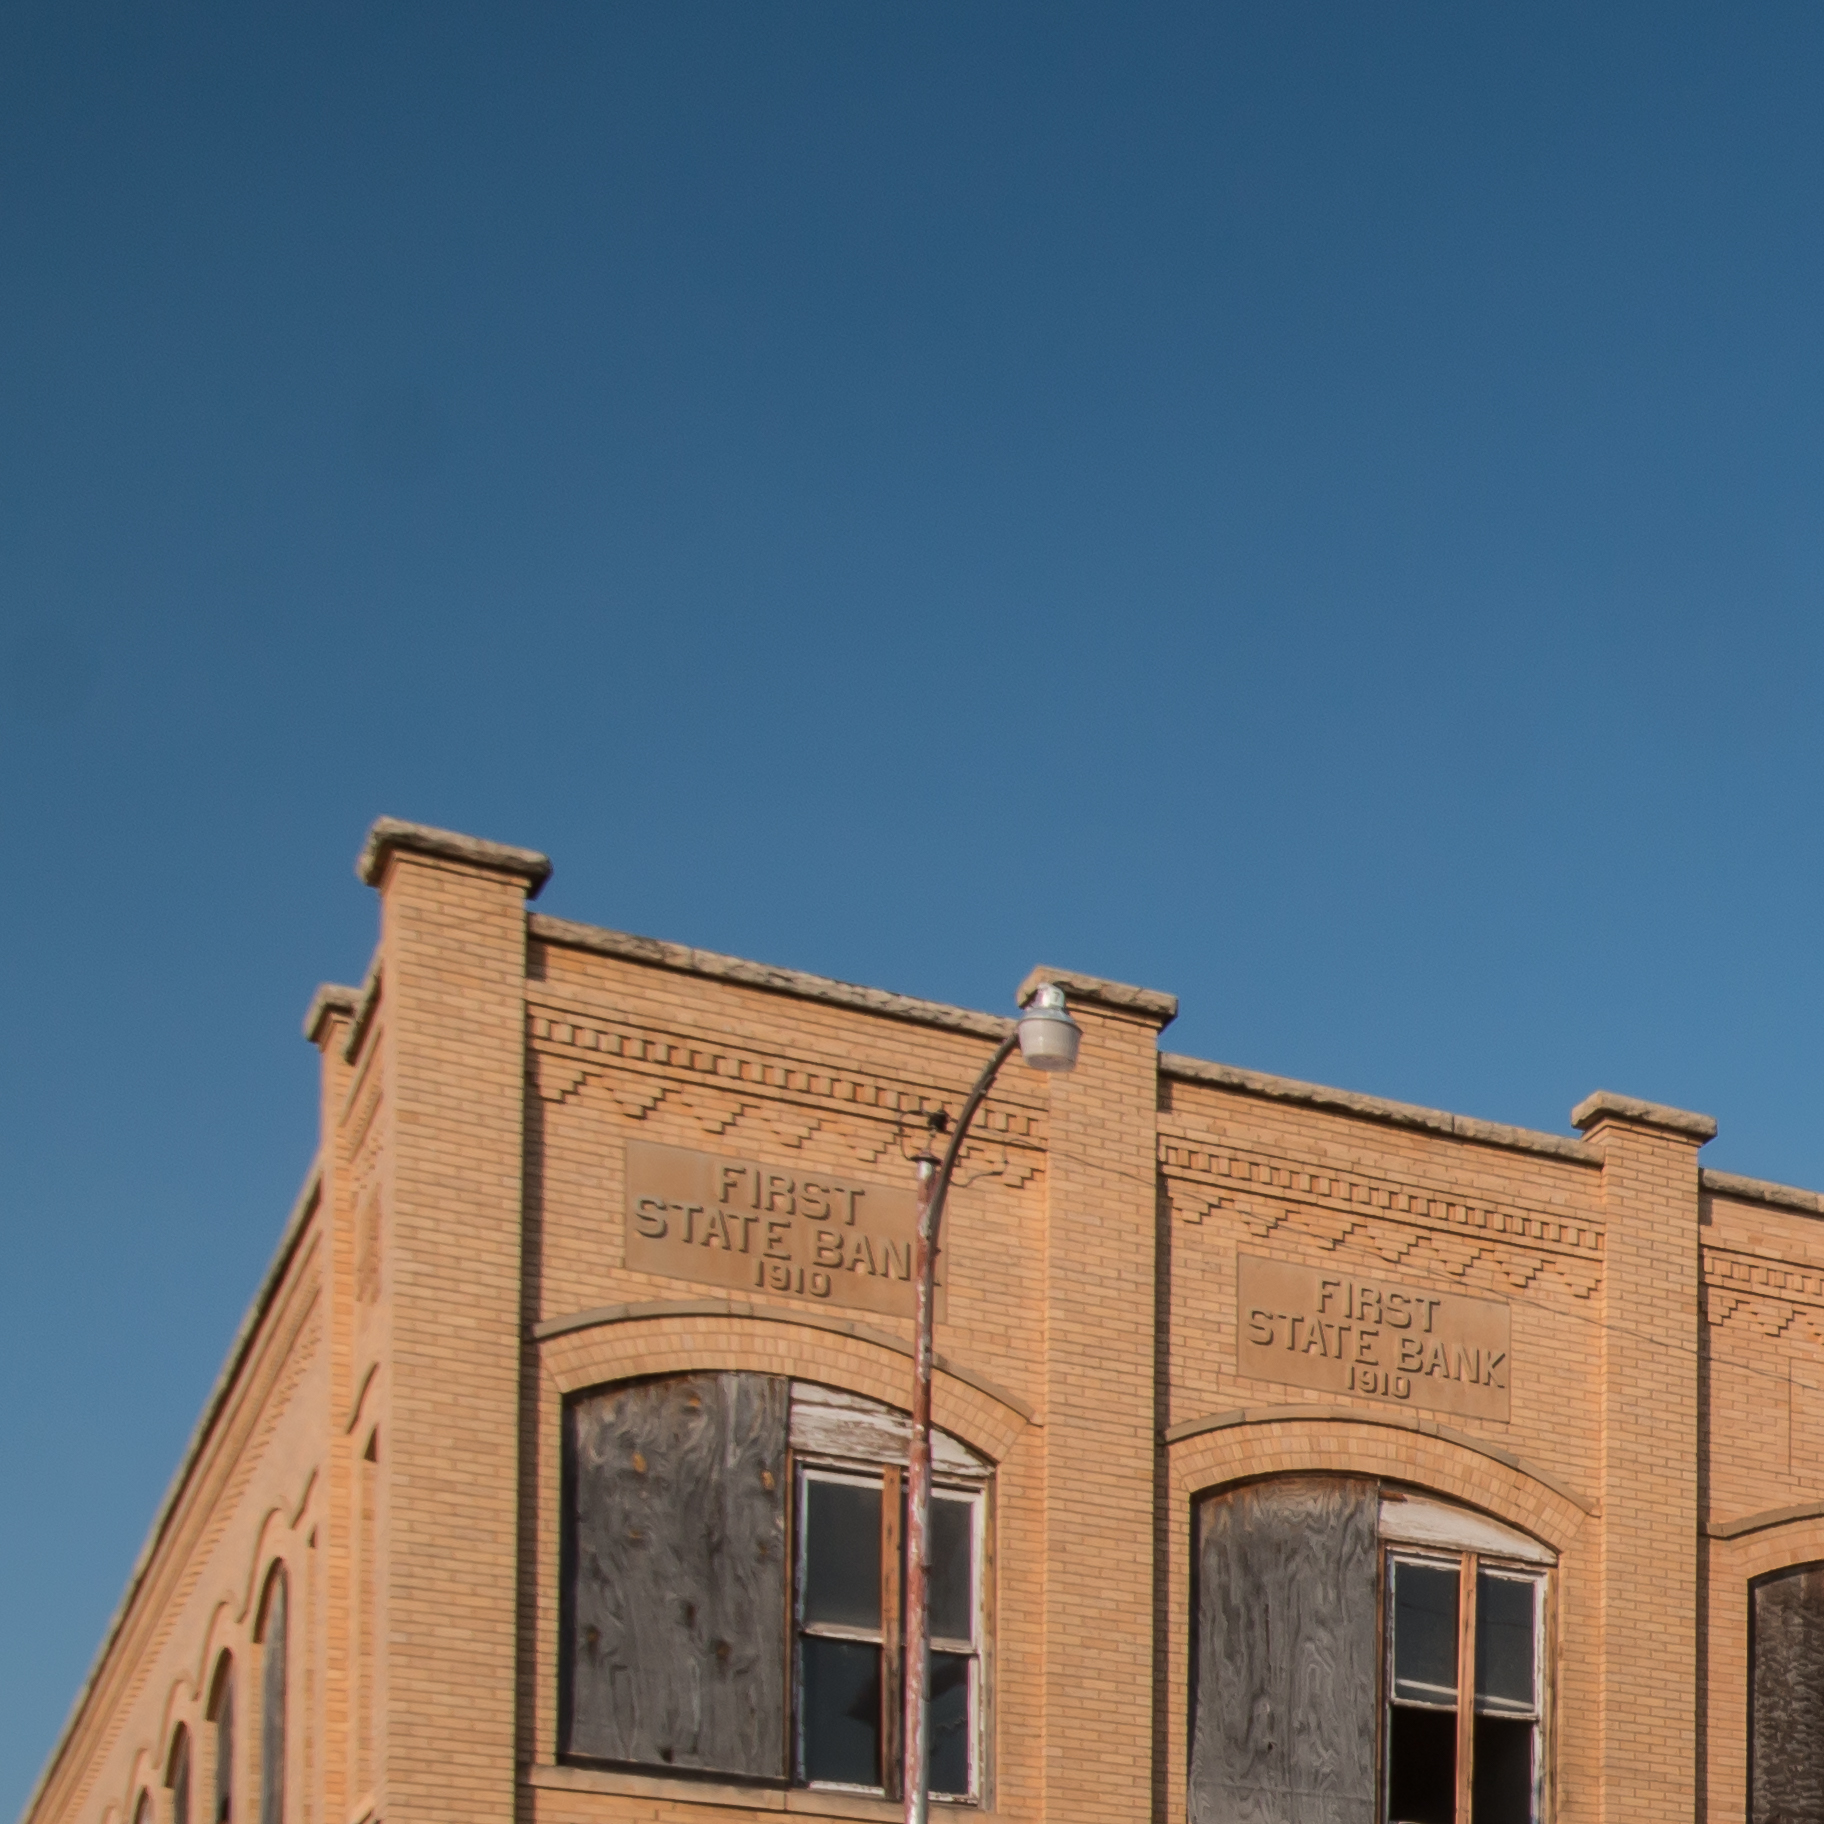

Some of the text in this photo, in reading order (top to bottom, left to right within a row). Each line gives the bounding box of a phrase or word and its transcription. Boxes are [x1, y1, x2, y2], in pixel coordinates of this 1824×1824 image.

[719, 1165, 866, 1226] FIRST
[635, 1196, 941, 1287] STATE BAN
[755, 1259, 832, 1298] 1910
[1316, 1276, 1441, 1334] FIRST
[1248, 1307, 1506, 1389] STATE BANK
[1347, 1364, 1412, 1399] 1910
